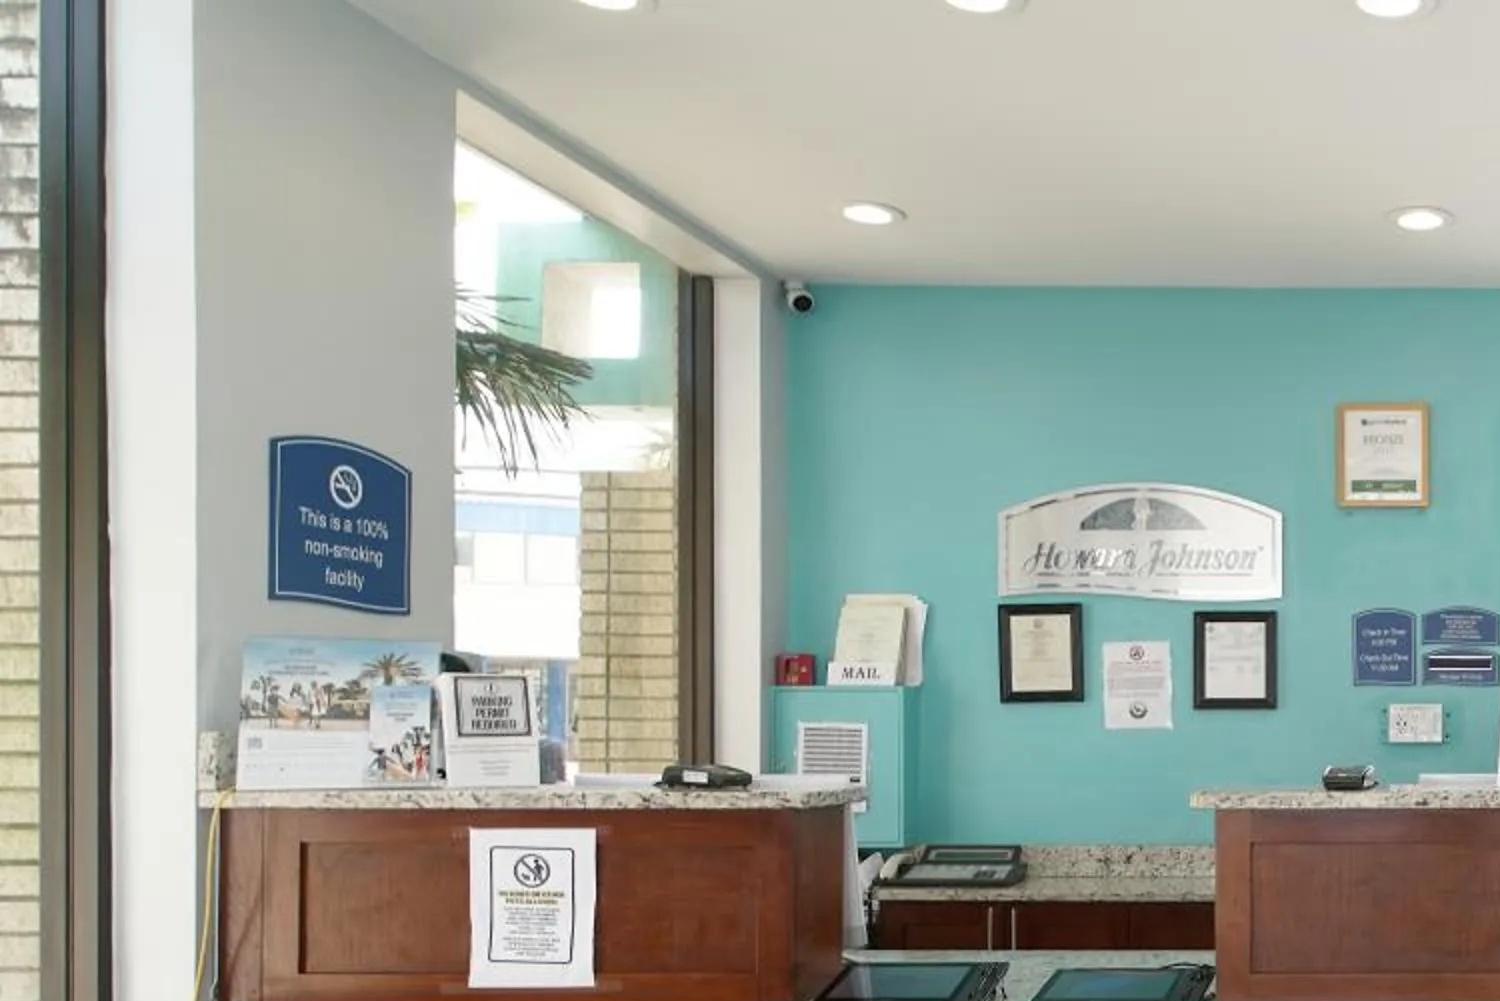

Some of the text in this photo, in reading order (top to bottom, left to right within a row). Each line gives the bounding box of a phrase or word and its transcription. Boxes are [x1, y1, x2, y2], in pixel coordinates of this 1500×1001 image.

[299, 506, 389, 540] This is a 100%
[305, 539, 383, 569] non-smoking
[1138, 539, 1258, 576] Johnson
[325, 566, 365, 592] facility
[841, 667, 880, 680] MAIL
